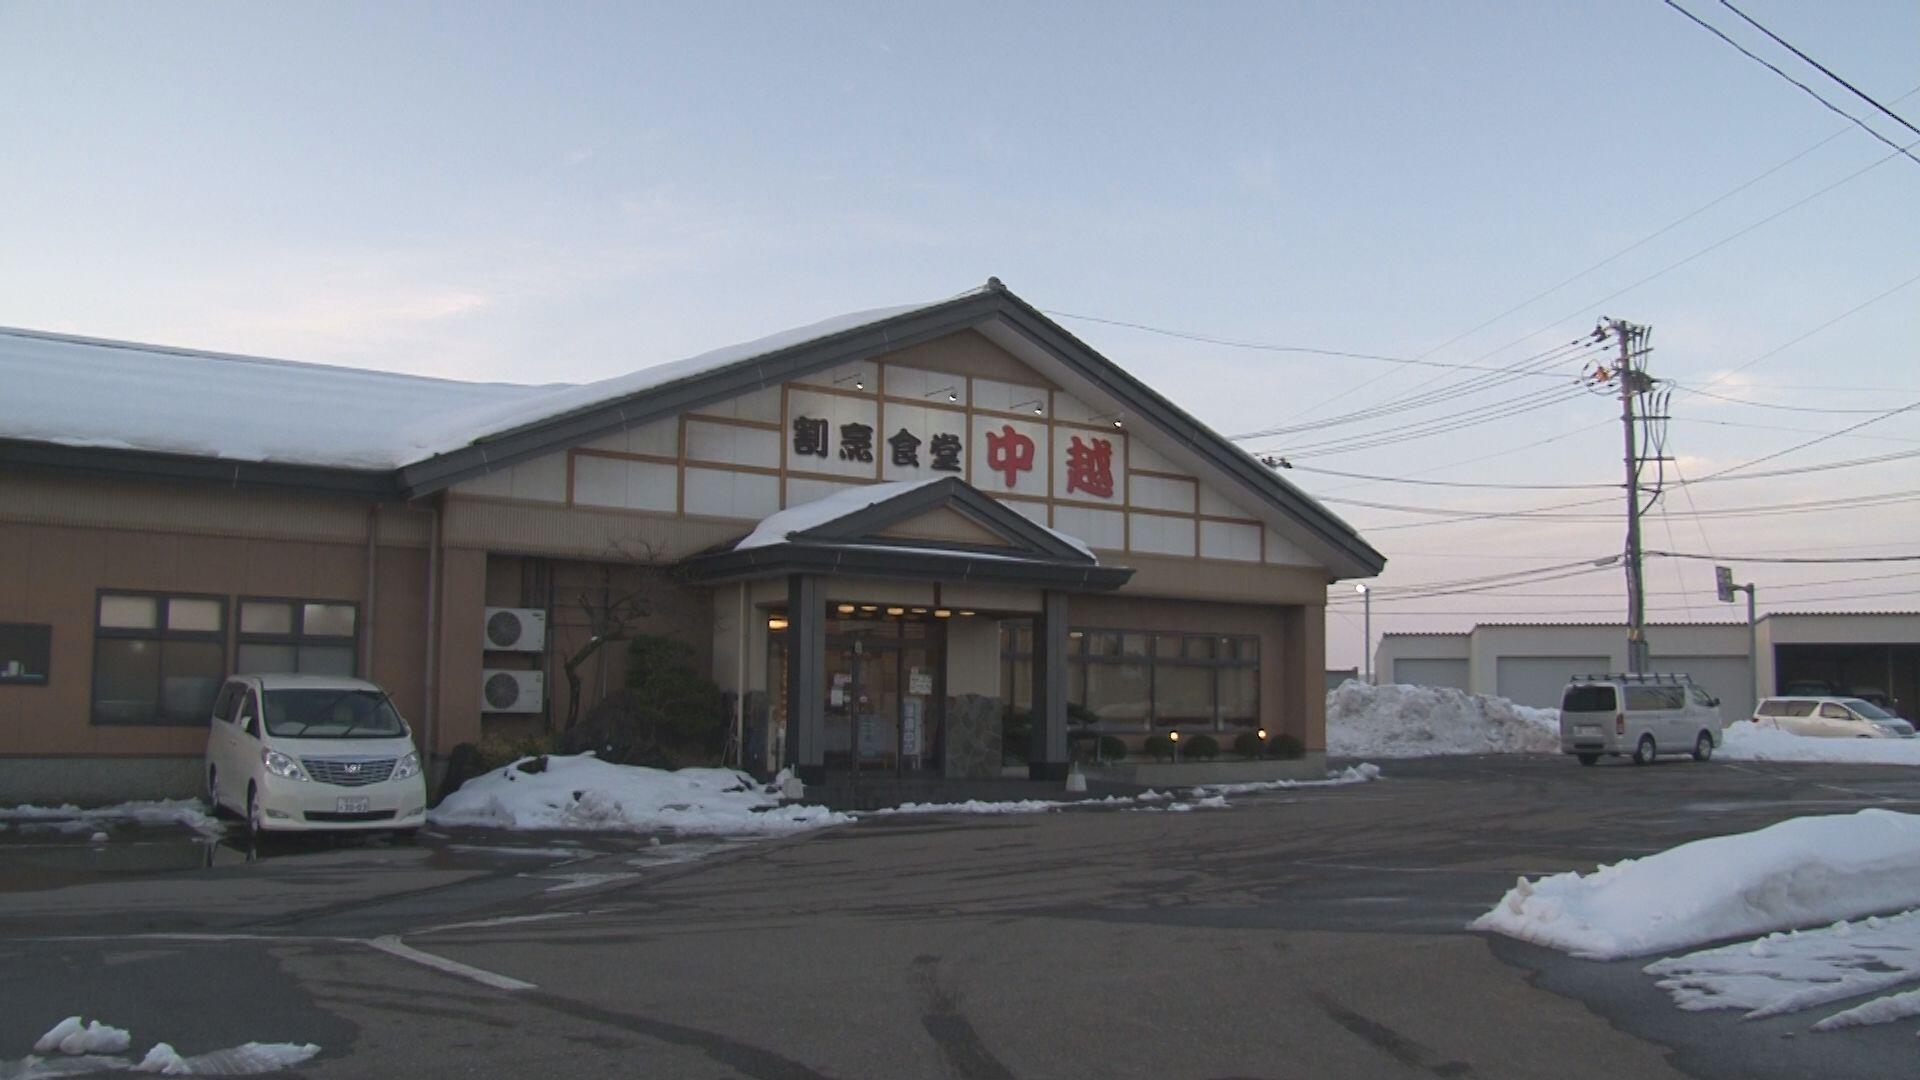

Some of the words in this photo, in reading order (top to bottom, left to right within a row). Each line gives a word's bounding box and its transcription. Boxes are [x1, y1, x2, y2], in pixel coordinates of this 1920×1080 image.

[793, 415, 962, 472] 割烹食堂
[986, 425, 1114, 498] 中越
